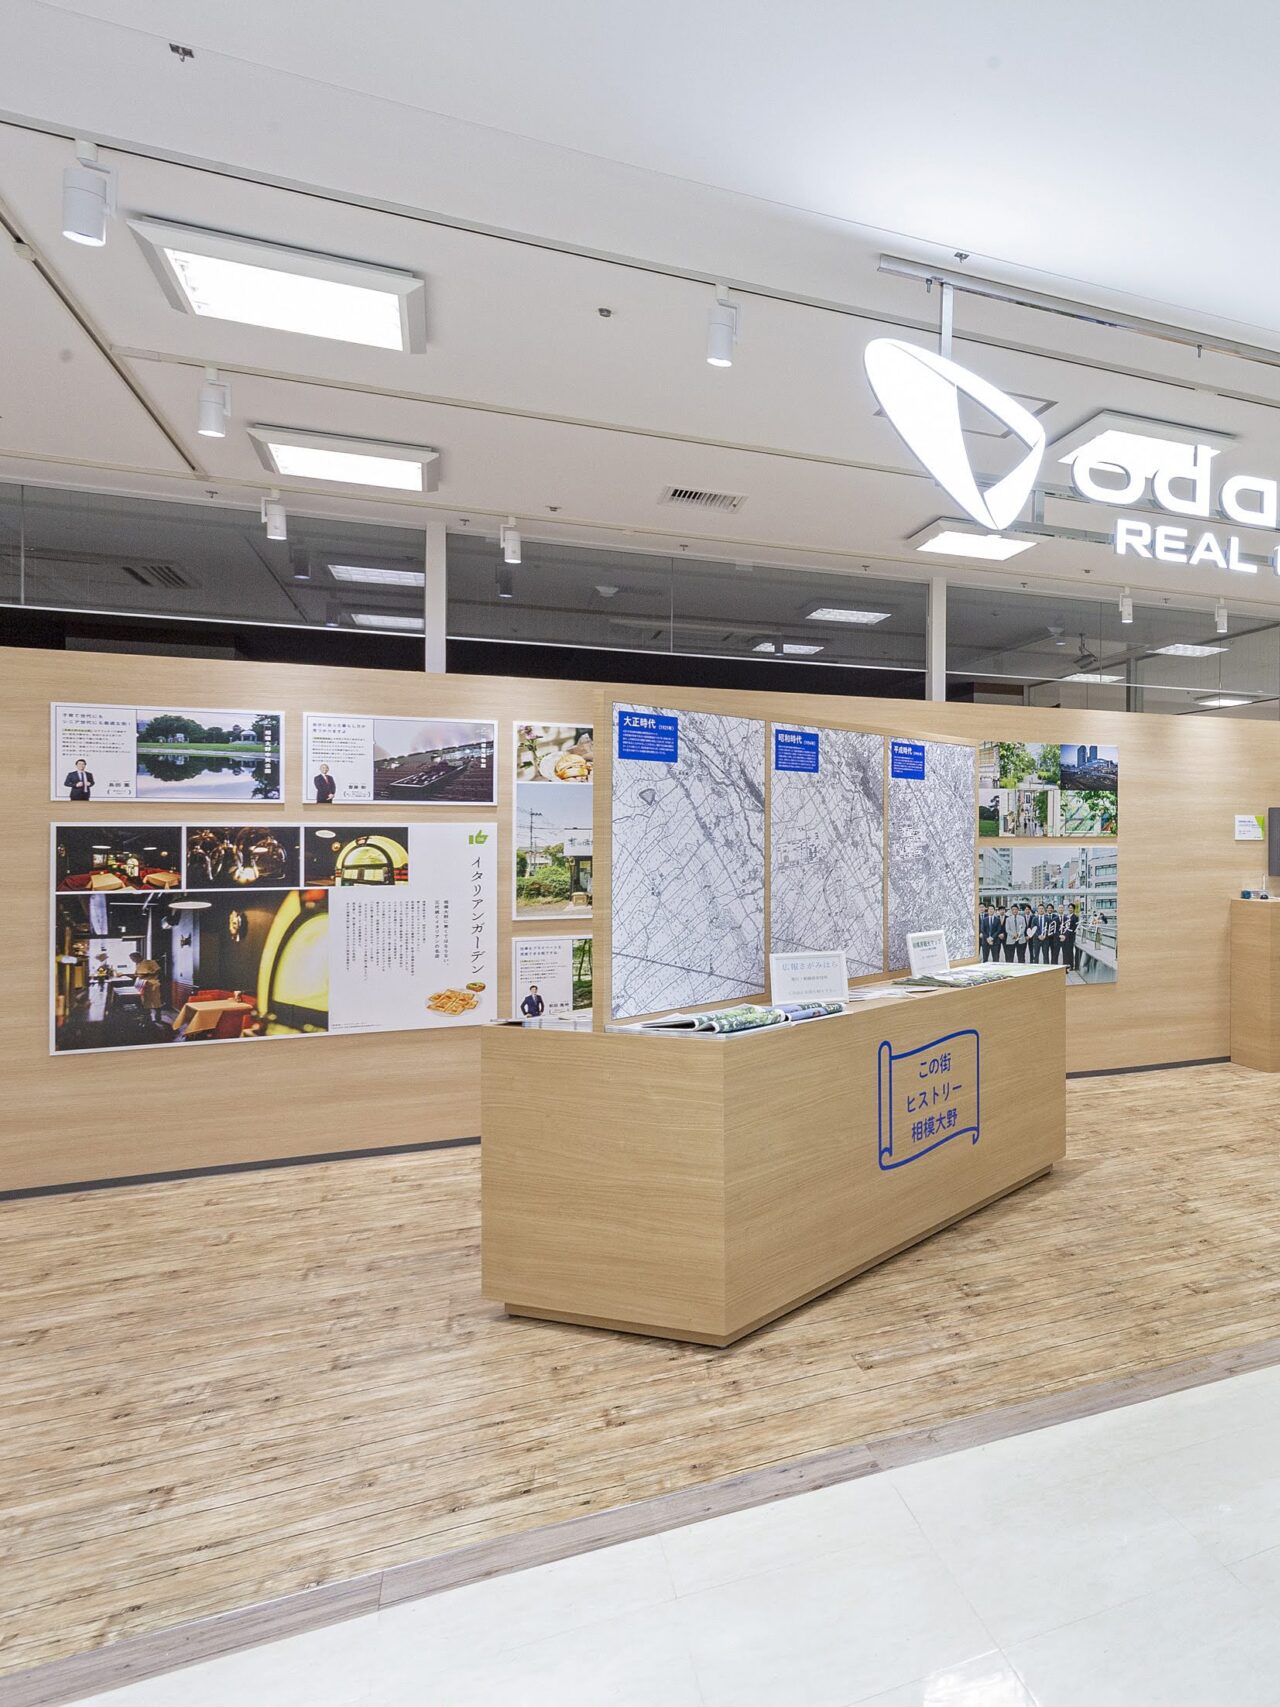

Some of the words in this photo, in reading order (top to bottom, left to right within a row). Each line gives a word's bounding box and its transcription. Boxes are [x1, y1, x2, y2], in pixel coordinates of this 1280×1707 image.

[1115, 518, 1258, 573] REAL
[623, 716, 656, 729] 大正時代
[778, 733, 803, 744] 昭和時代
[893, 745, 912, 755] 平成時代
[471, 856, 486, 974] イタリアンガーデン
[782, 961, 838, 971] 広報さがみはら
[919, 1053, 951, 1079] この街
[906, 1082, 962, 1113] ヒストリー
[911, 1108, 958, 1142] 相模大野
